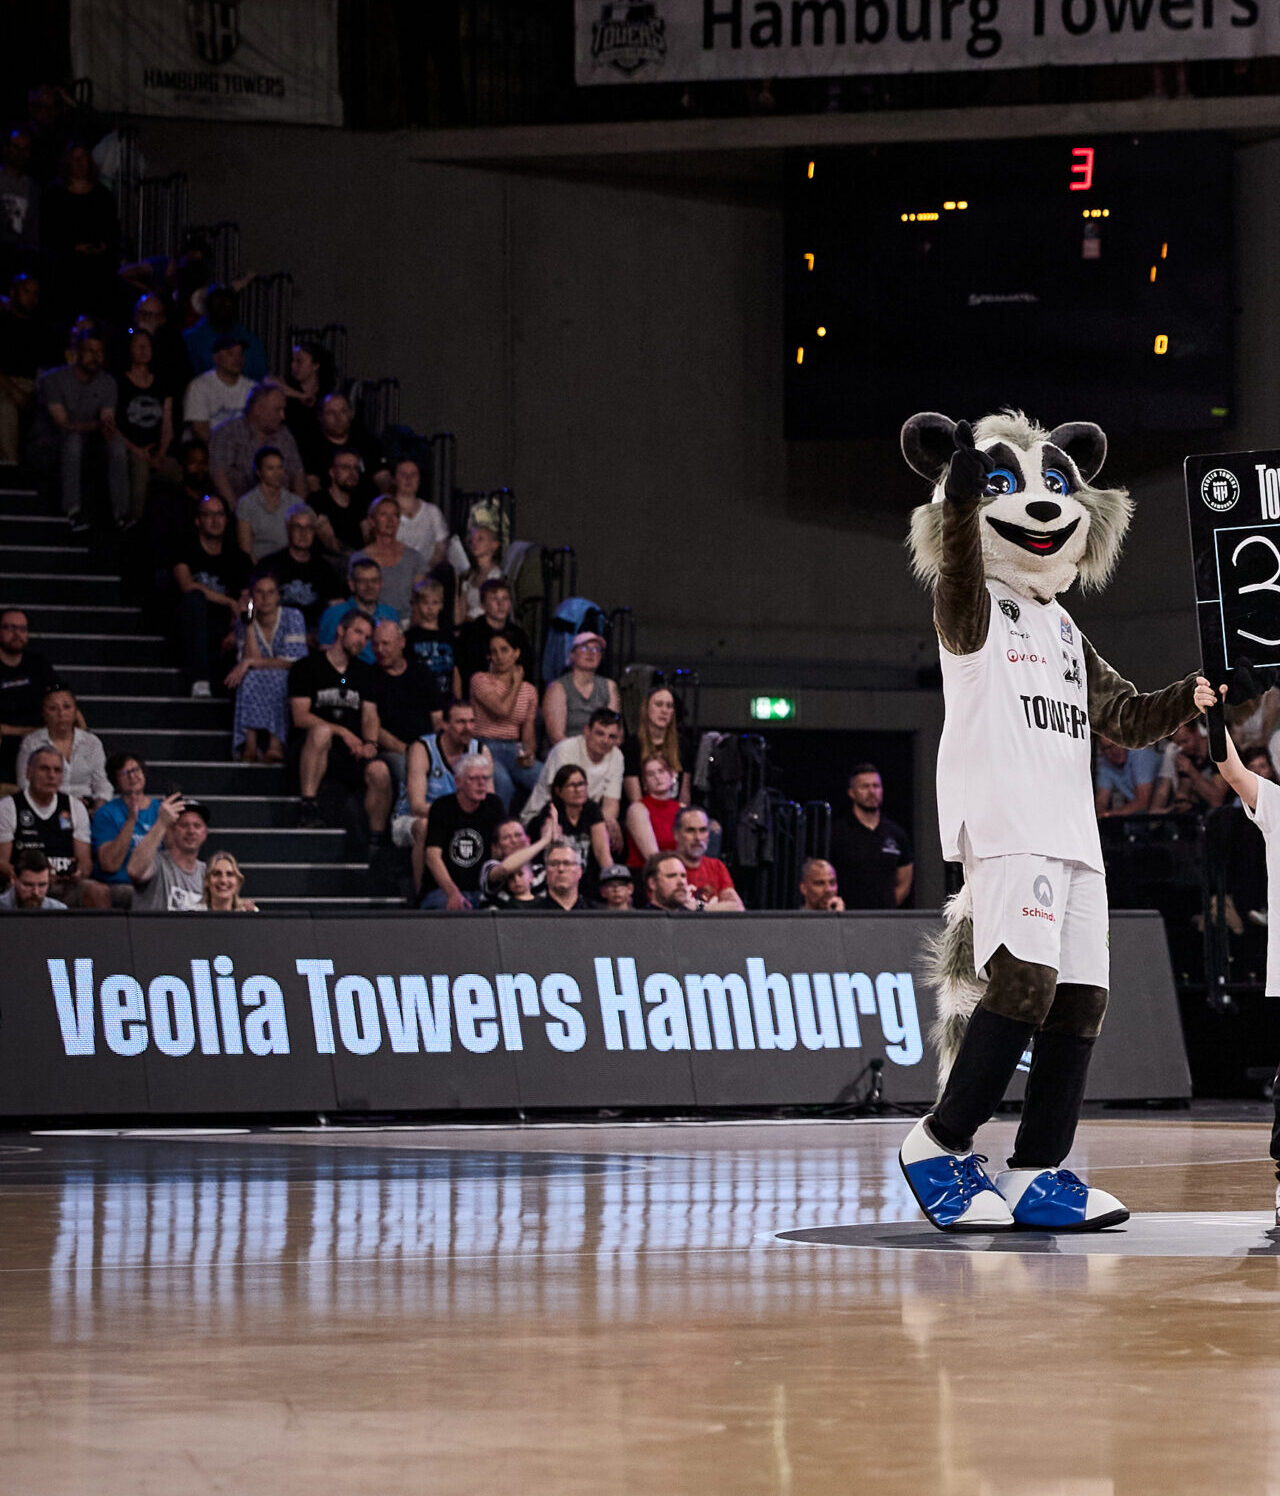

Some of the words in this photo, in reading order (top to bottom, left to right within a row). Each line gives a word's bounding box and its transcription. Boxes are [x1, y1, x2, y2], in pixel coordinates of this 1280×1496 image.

[703, 0, 1001, 58] Hamburg
[143, 70, 219, 93] HAMBURG
[222, 74, 286, 97] TOWERS
[1022, 906, 1056, 923] Schind
[47, 955, 290, 1057] Veolia
[295, 959, 586, 1055] Towers
[594, 956, 925, 1066] Hamburg
